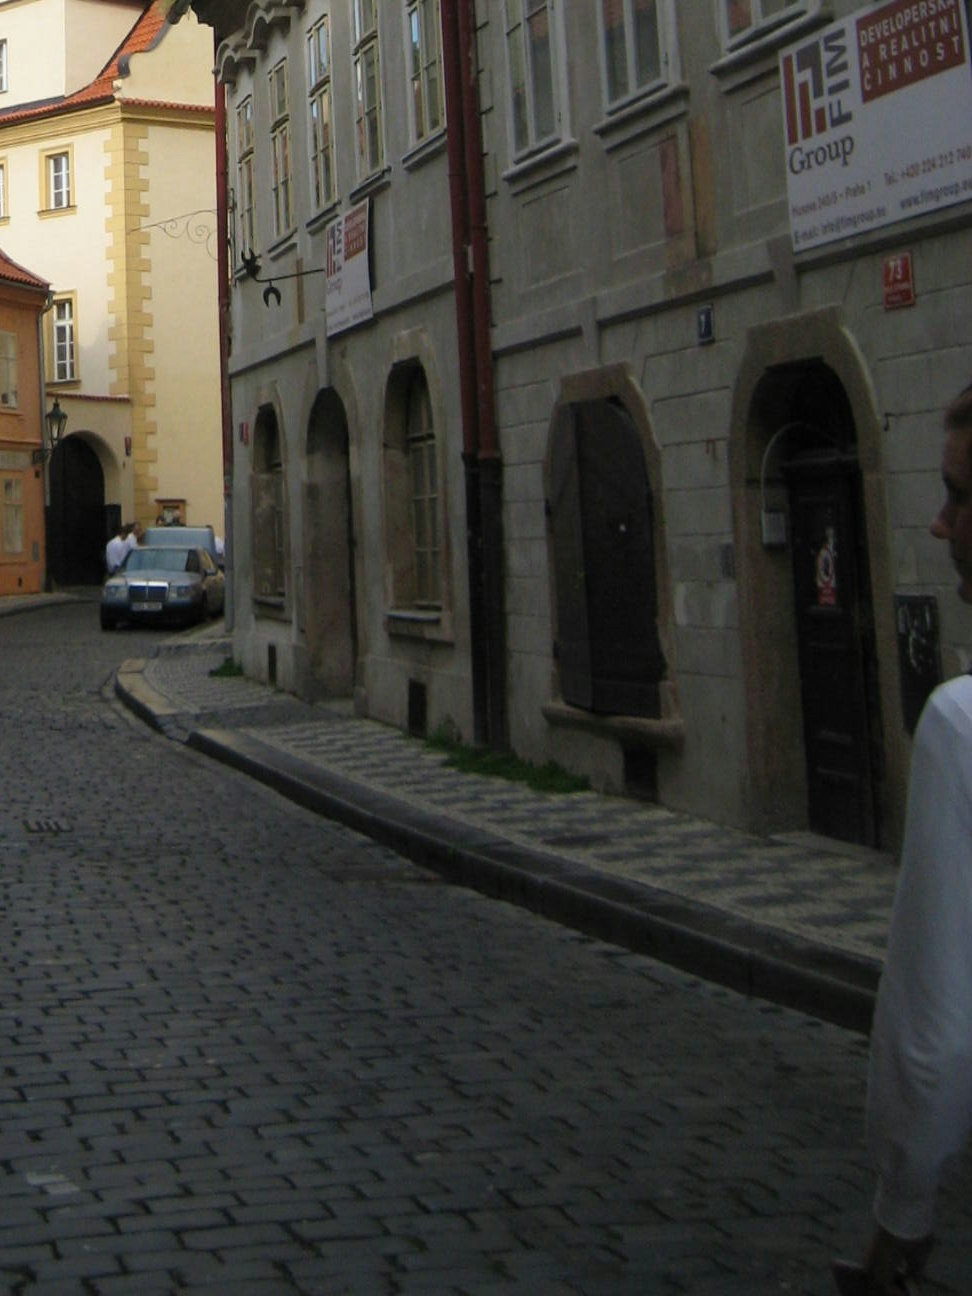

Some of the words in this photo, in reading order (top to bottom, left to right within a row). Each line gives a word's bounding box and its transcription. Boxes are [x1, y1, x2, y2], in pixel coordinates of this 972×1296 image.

[862, 51, 870, 69] A
[879, 8, 958, 61] REALITNÍ
[863, 35, 960, 91] ČINNOST
[823, 27, 853, 129] FIM
[789, 135, 855, 175] Group
